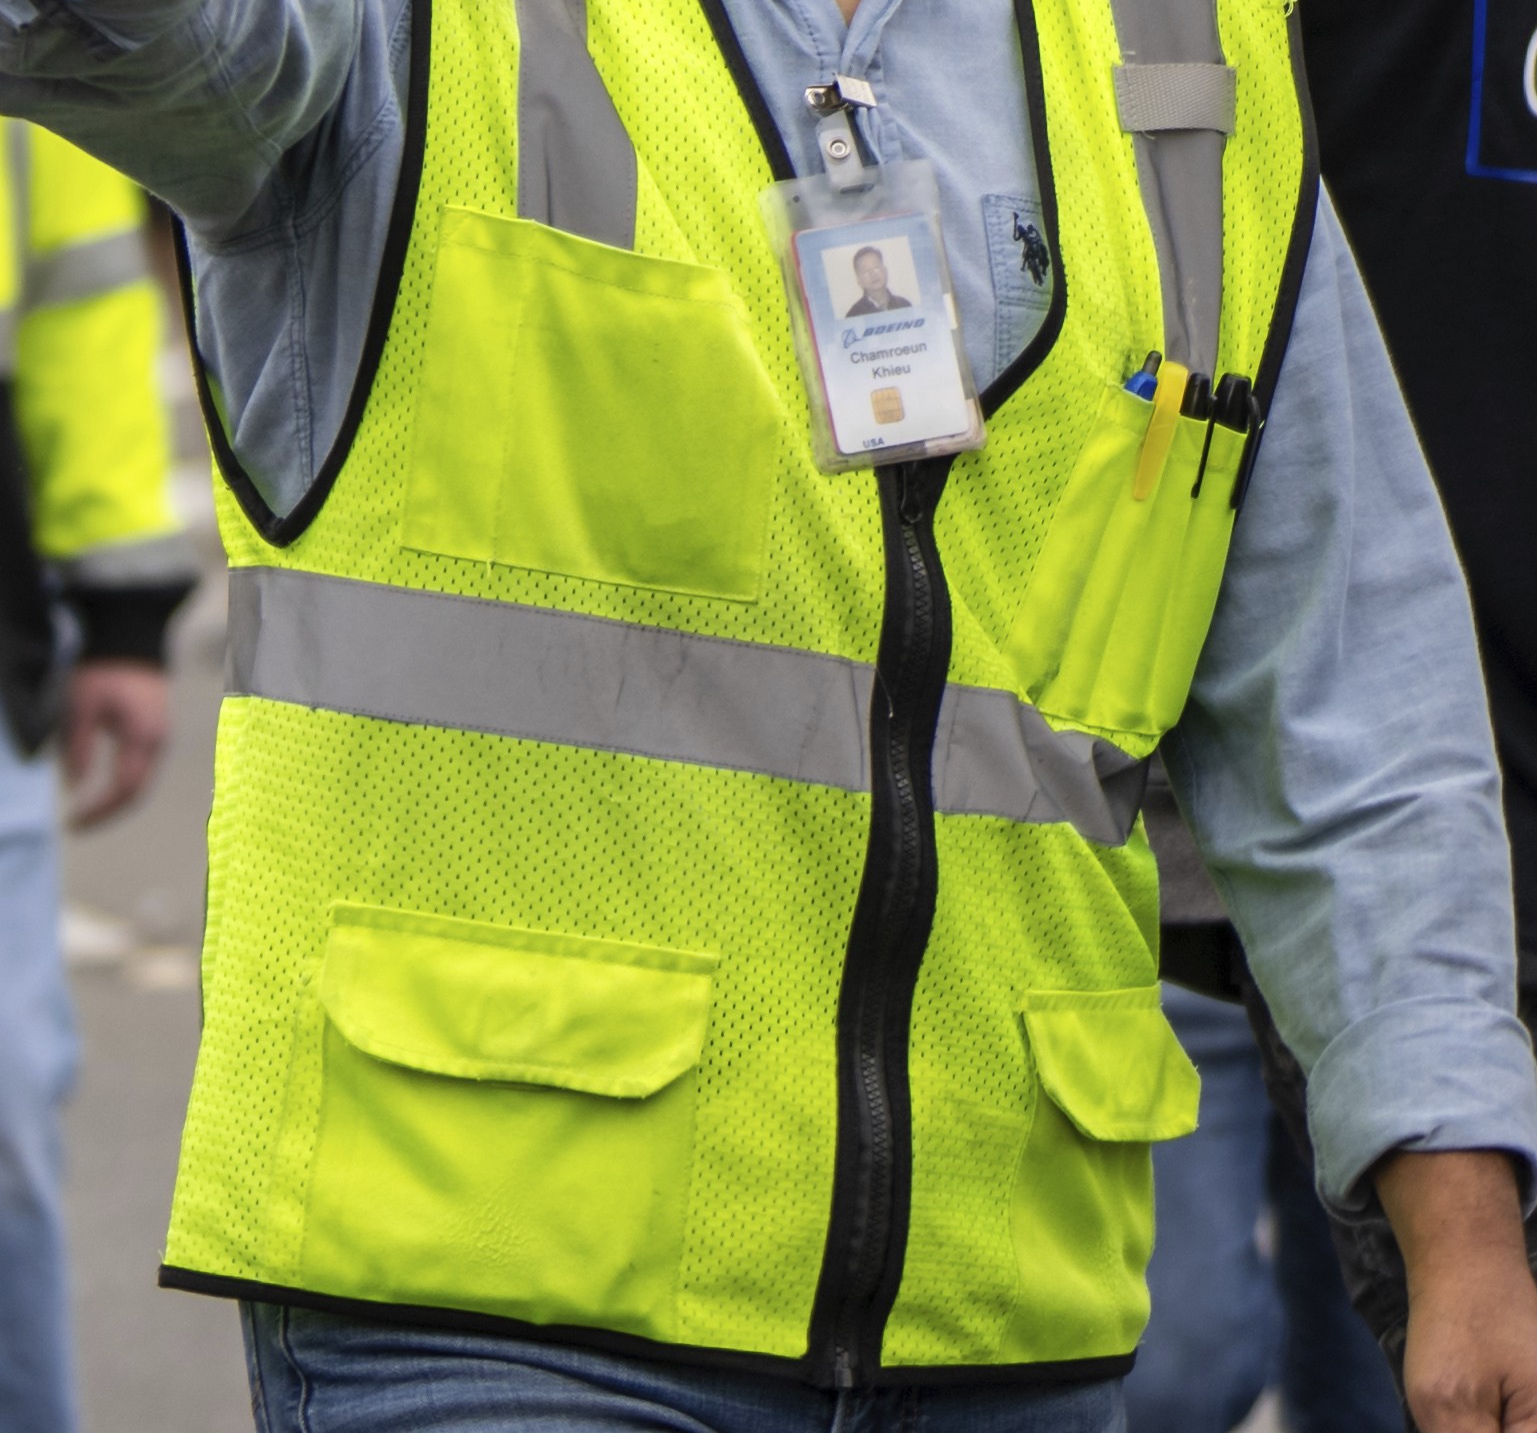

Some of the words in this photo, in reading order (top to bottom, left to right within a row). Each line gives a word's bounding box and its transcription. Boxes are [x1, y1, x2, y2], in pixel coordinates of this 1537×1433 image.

[850, 342, 928, 364] Chamroeun
[872, 365, 911, 379] Khieu
[862, 437, 885, 449] USA
